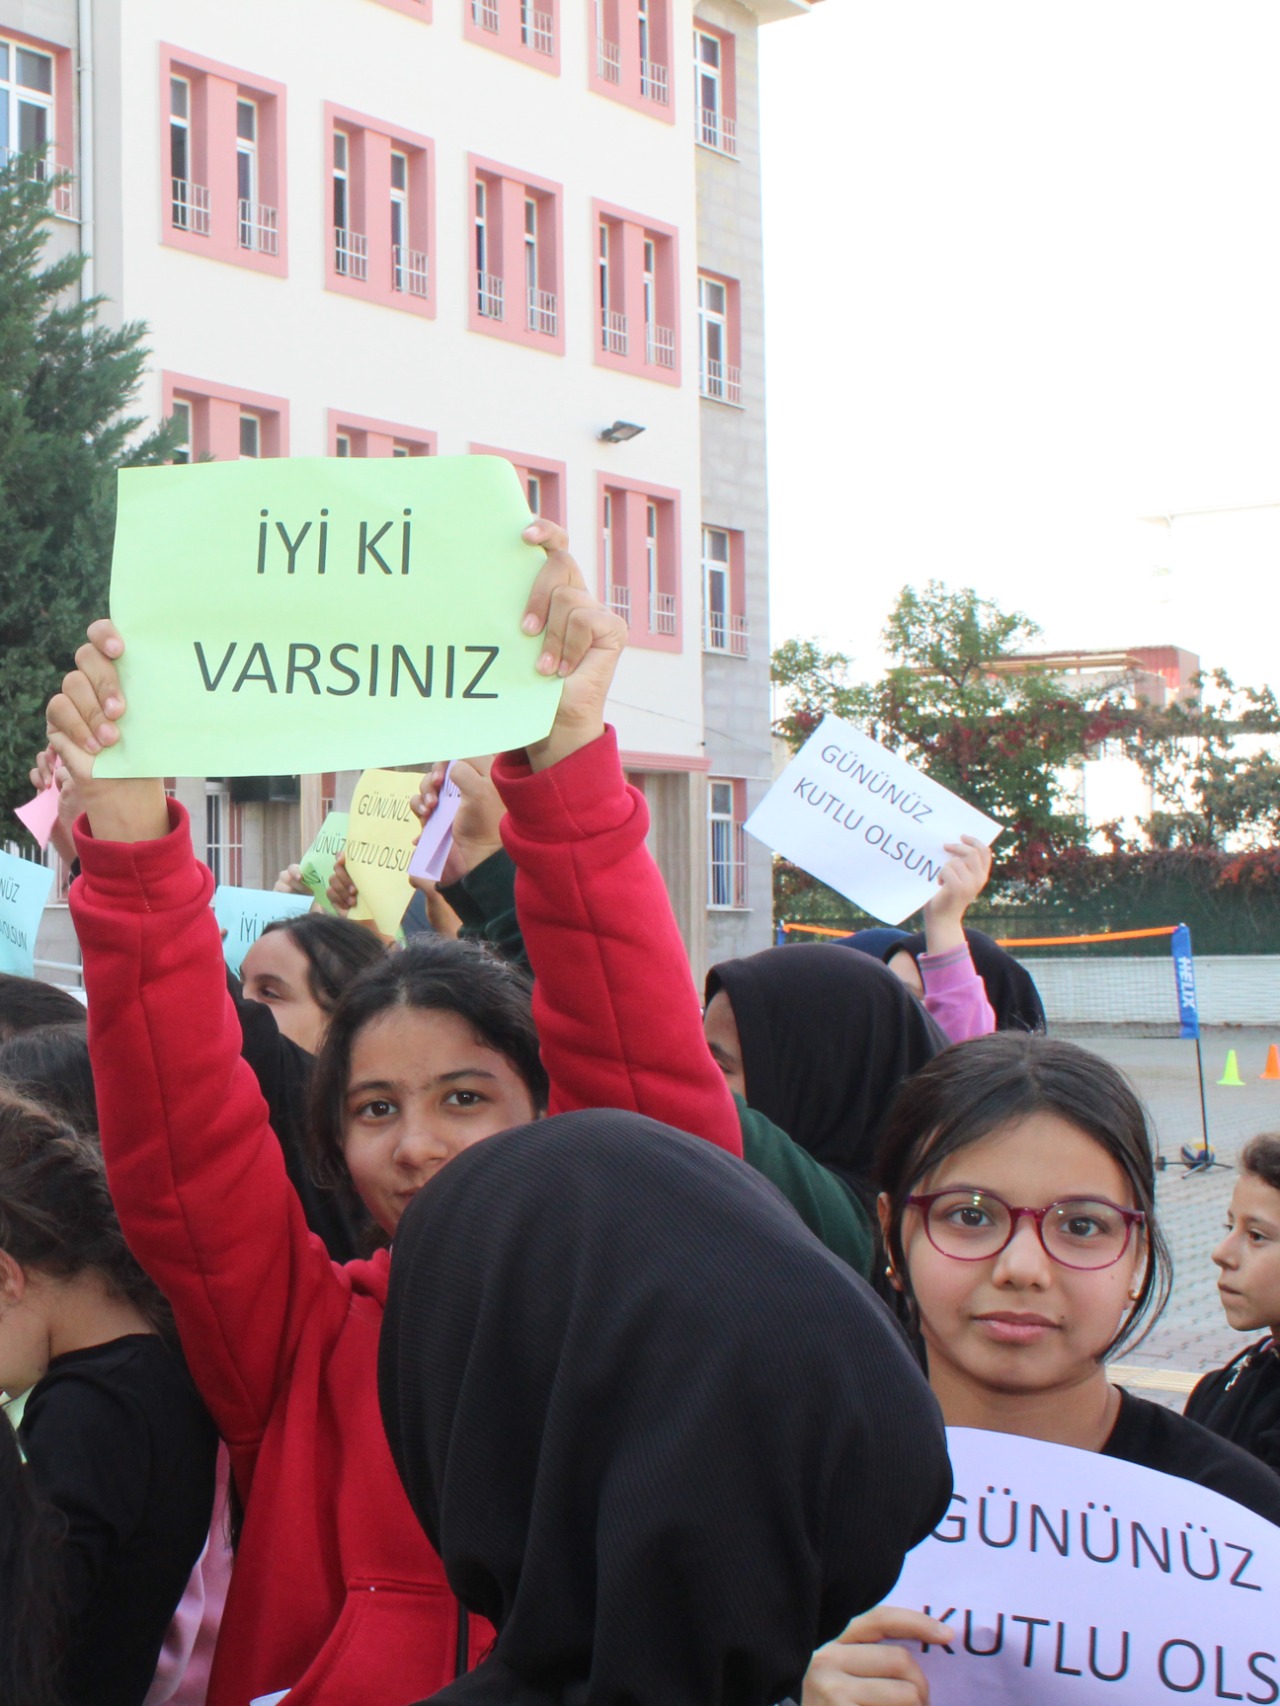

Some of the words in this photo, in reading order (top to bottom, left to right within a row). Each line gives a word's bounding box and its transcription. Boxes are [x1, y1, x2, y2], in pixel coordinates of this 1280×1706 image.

[256, 508, 329, 575] İYİ
[357, 508, 412, 575] Kİ
[193, 642, 500, 699] VARSINIZ
[821, 745, 933, 823] GÜNÜNÜZ
[378, 846, 413, 872] OLSU
[793, 777, 864, 830] KUTLU
[864, 824, 941, 882] OLSUN
